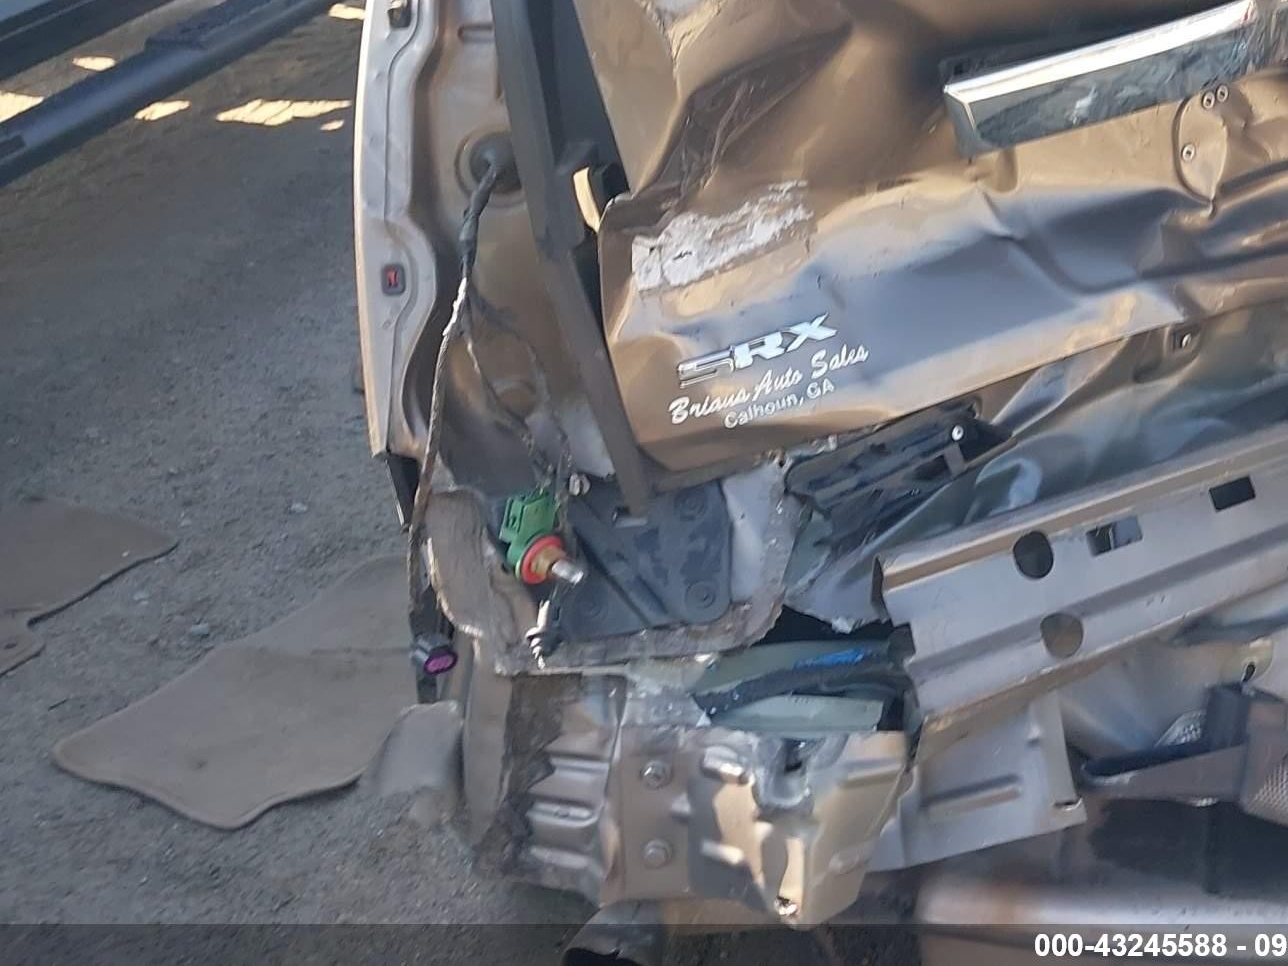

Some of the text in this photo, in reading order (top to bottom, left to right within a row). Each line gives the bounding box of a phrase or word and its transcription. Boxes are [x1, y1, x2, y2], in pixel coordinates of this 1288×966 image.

[676, 312, 838, 389] SRX
[752, 367, 803, 402] Auto
[810, 343, 870, 379] Sales
[724, 377, 836, 429] Calhoun, GA
